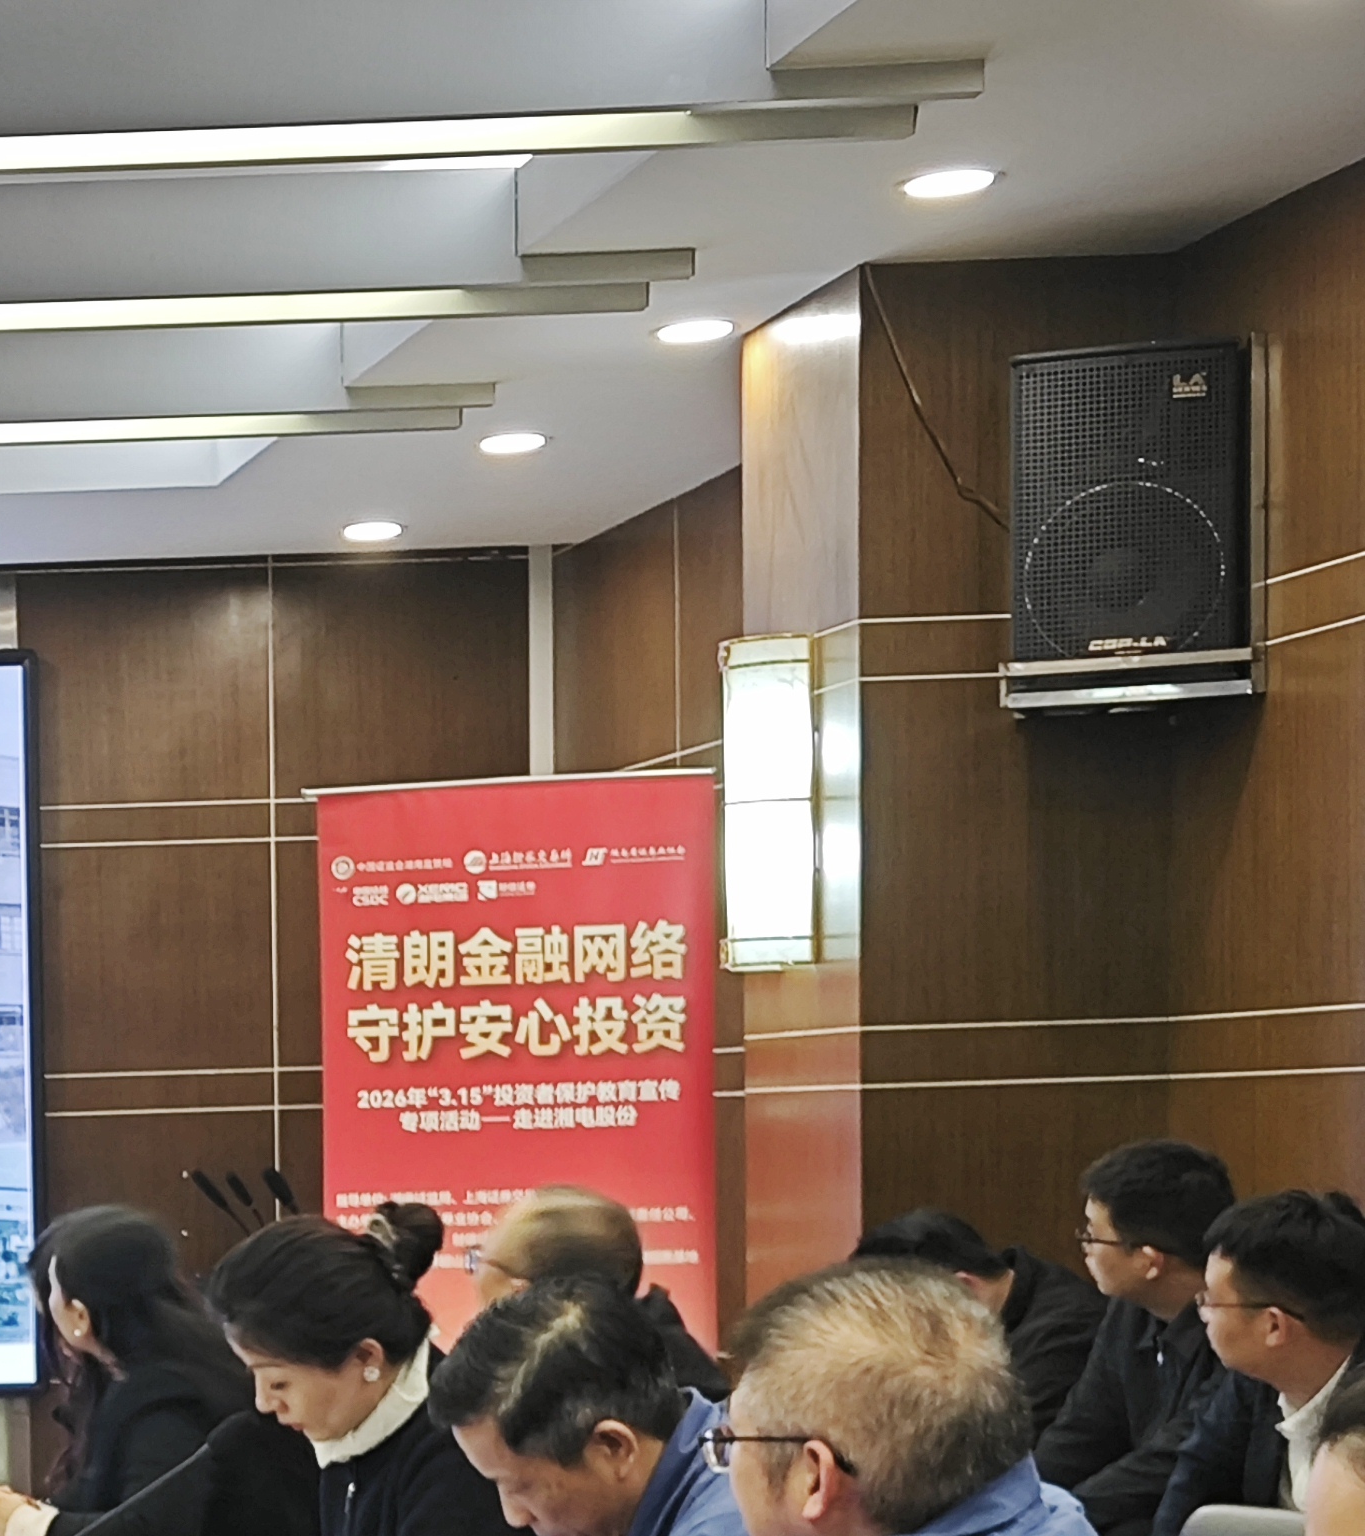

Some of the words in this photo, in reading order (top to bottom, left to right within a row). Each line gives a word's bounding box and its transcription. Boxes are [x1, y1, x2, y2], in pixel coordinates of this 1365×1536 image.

[346, 920, 687, 991] 清朗金融网络
[347, 993, 686, 1063] 守护安心投资
